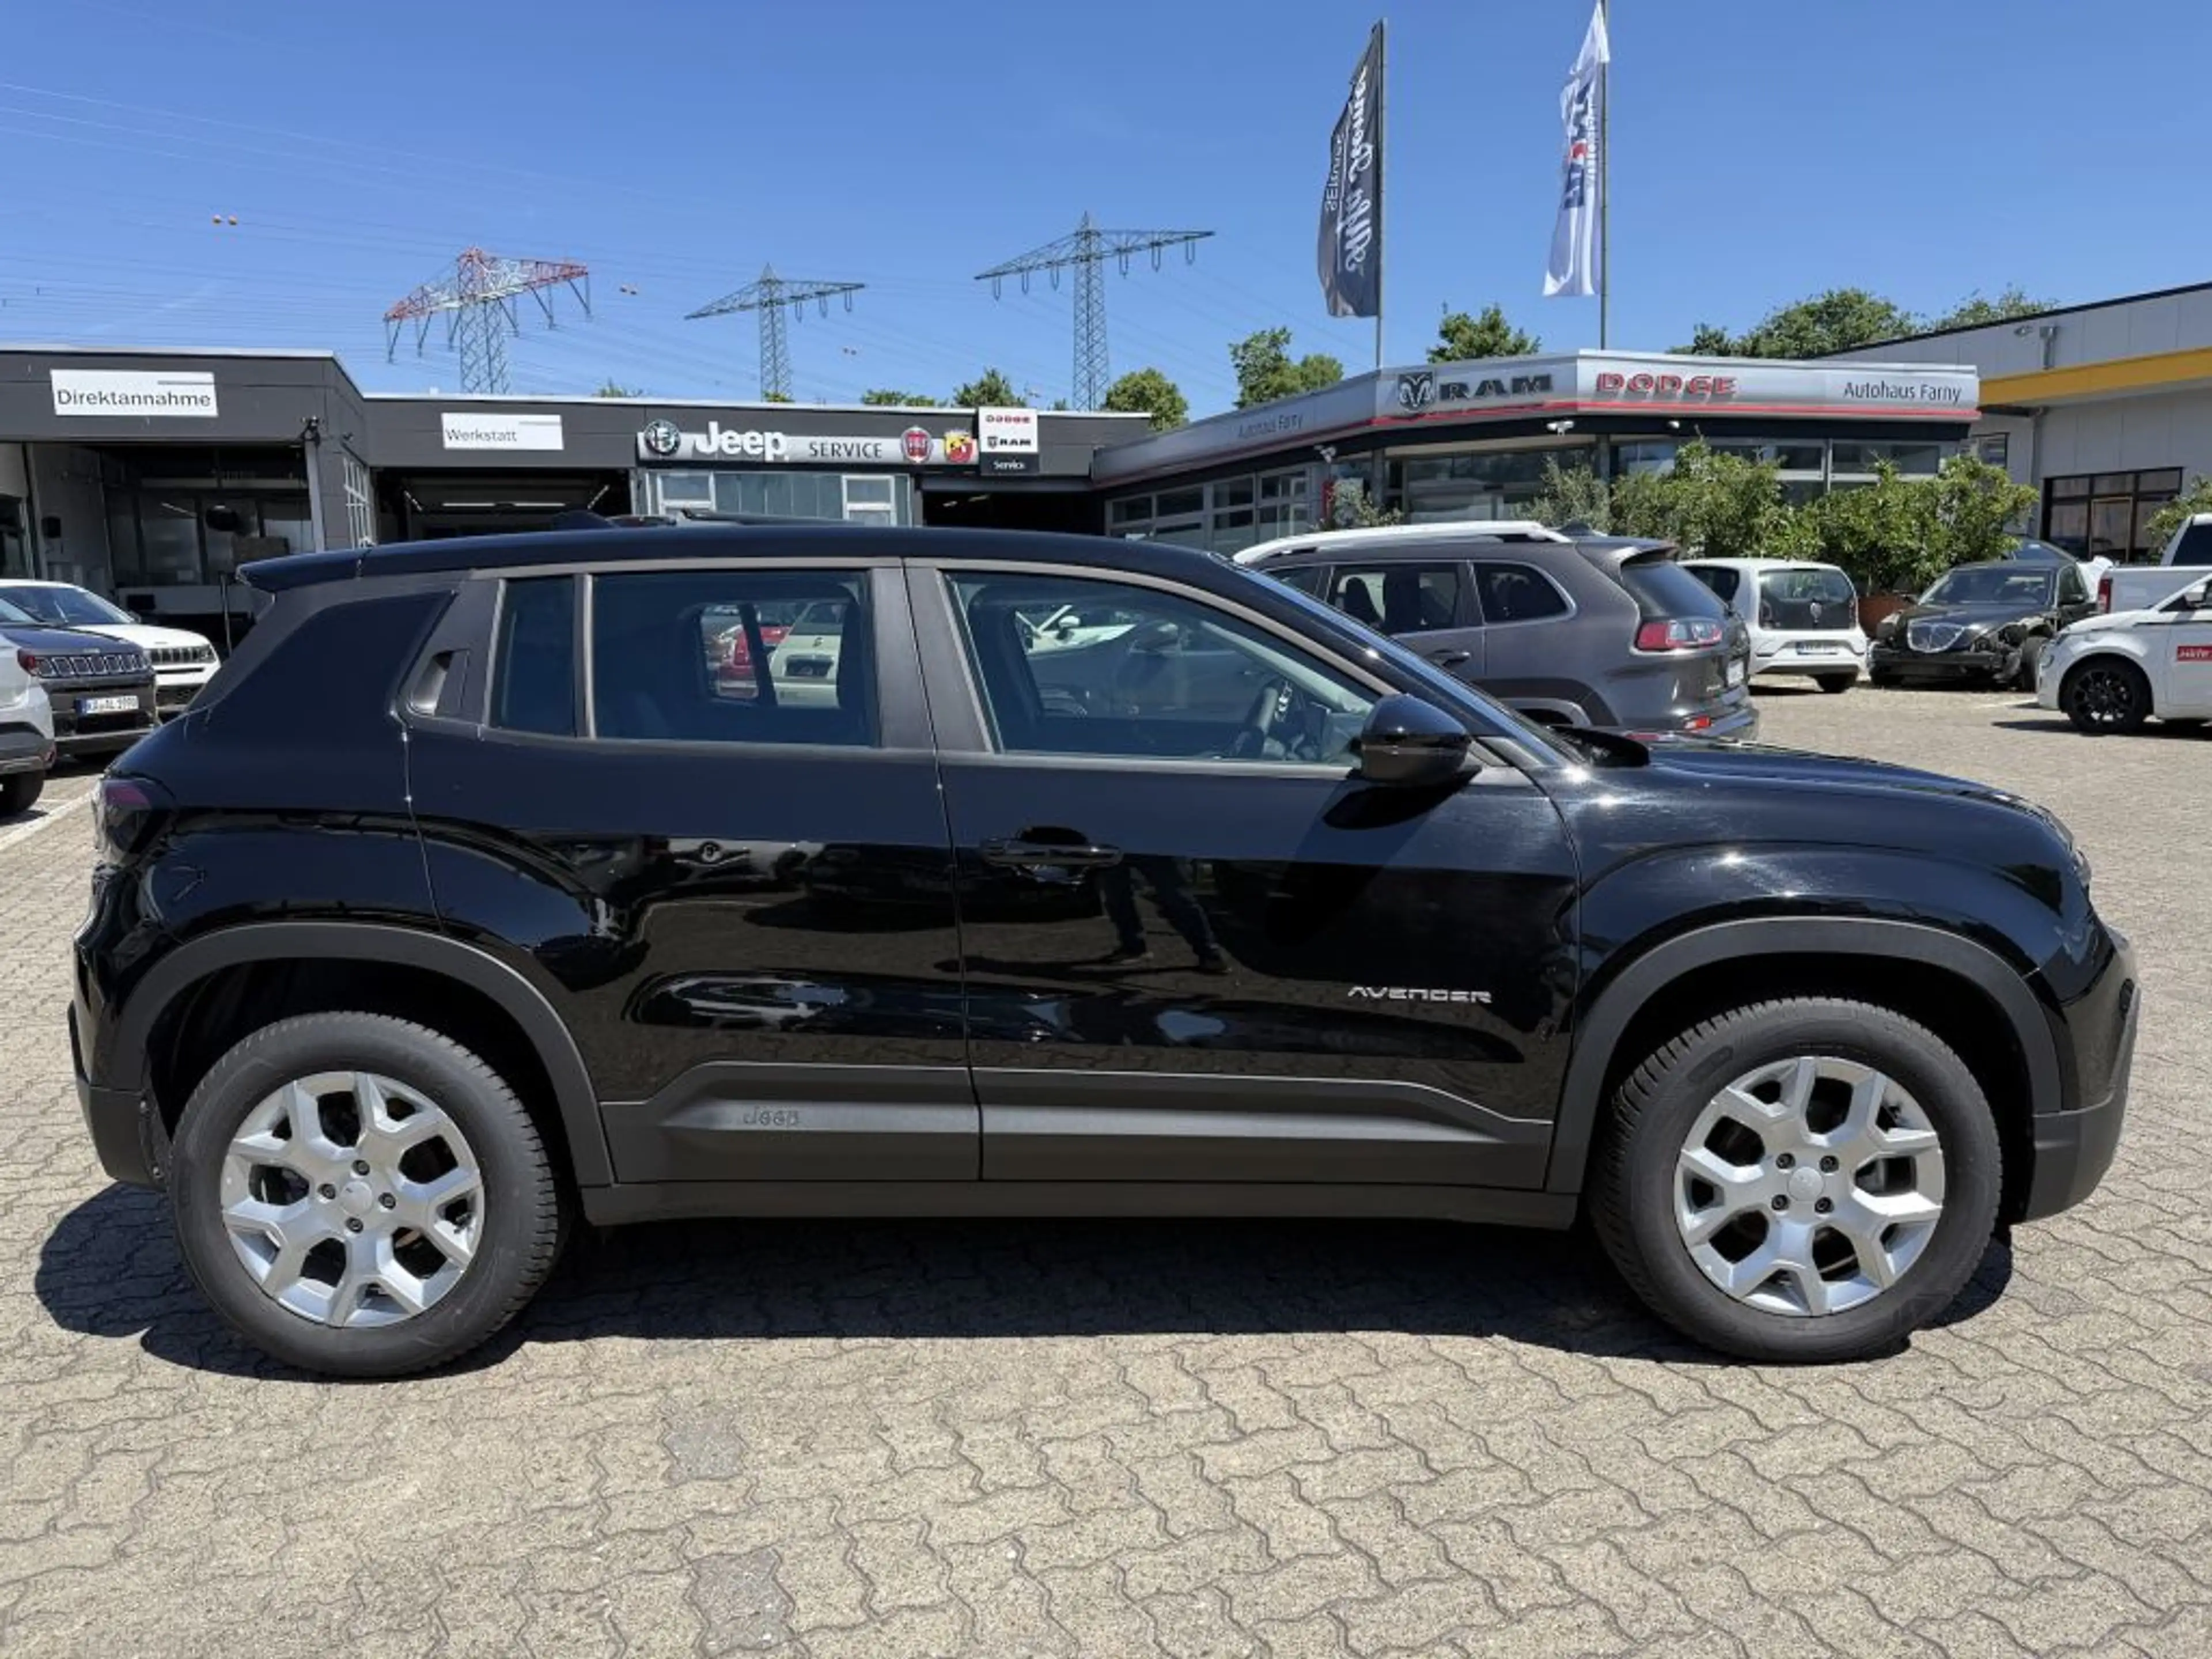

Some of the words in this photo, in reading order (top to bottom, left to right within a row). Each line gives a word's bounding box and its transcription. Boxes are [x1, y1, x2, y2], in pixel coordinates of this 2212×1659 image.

[1440, 374, 1553, 401] RAM
[1595, 373, 1737, 394] DODGE
[1844, 380, 1916, 399] Autohaus
[1920, 384, 1962, 406] Farny
[57, 389, 211, 407] Direktannahme
[445, 429, 517, 442] Werkstatt
[695, 421, 789, 461] Jeep
[809, 441, 882, 459] SERVICE
[1347, 986, 1492, 1003] AVENGER
